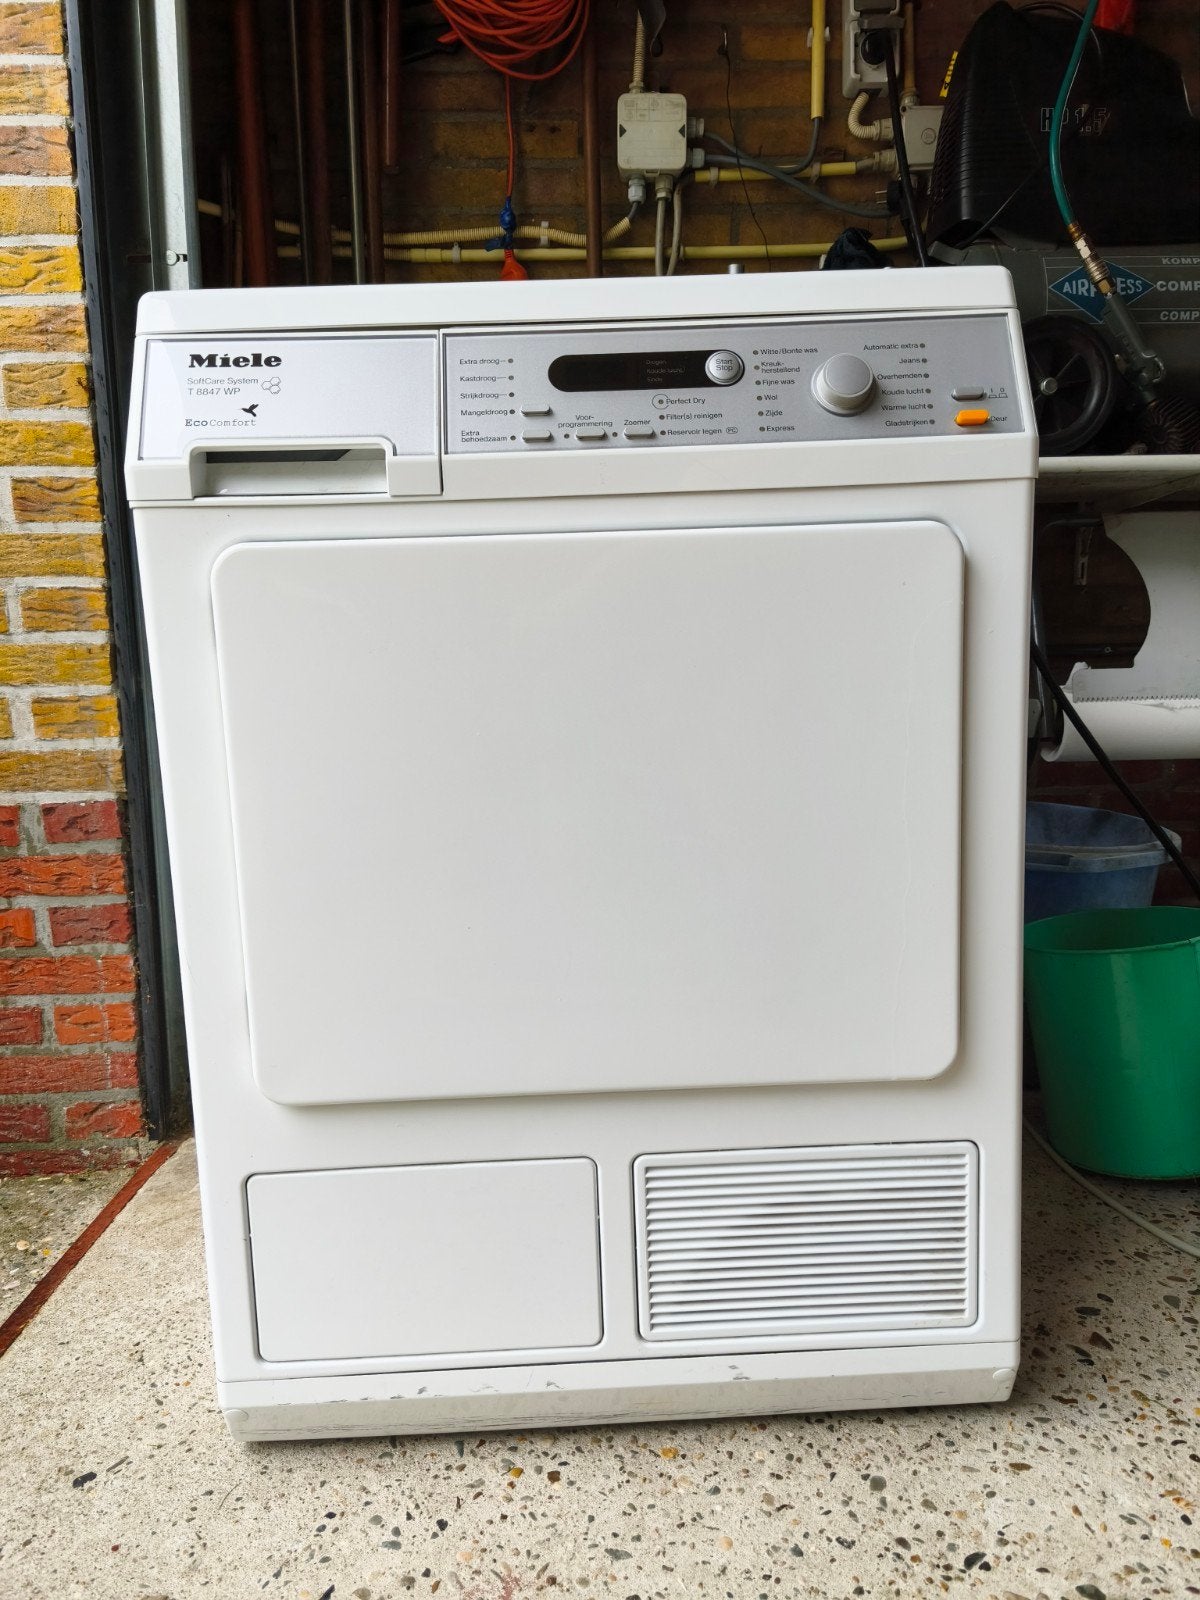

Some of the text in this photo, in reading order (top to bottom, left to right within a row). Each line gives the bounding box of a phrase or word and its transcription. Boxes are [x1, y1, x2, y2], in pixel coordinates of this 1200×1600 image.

[1062, 277, 1143, 297] AIRESS
[863, 343, 899, 351] Automatic
[188, 353, 282, 368] Miele
[479, 357, 500, 366] droog
[715, 358, 733, 366] Start
[715, 364, 734, 372] Stop
[459, 375, 497, 383] Kastdroog
[877, 372, 923, 380] Overhemden
[187, 377, 259, 386] SoftCare System
[762, 379, 779, 387] Fijne
[188, 387, 241, 395] T 8847 WP
[881, 387, 925, 396] Koude lucht
[460, 391, 500, 400] Strijkdroog
[666, 397, 706, 405] Perfect Dry
[907, 402, 927, 410] lucht
[460, 408, 508, 416] Mangeldroog
[765, 409, 783, 417] Zijde
[666, 412, 723, 421] Filter(s) reinigen
[557, 420, 613, 429] programmering
[885, 418, 929, 427] Gladstrijken
[667, 428, 701, 436] Reservoir
[702, 427, 722, 436] legen
[766, 425, 795, 433] Express
[461, 435, 508, 443] behoedzaam
